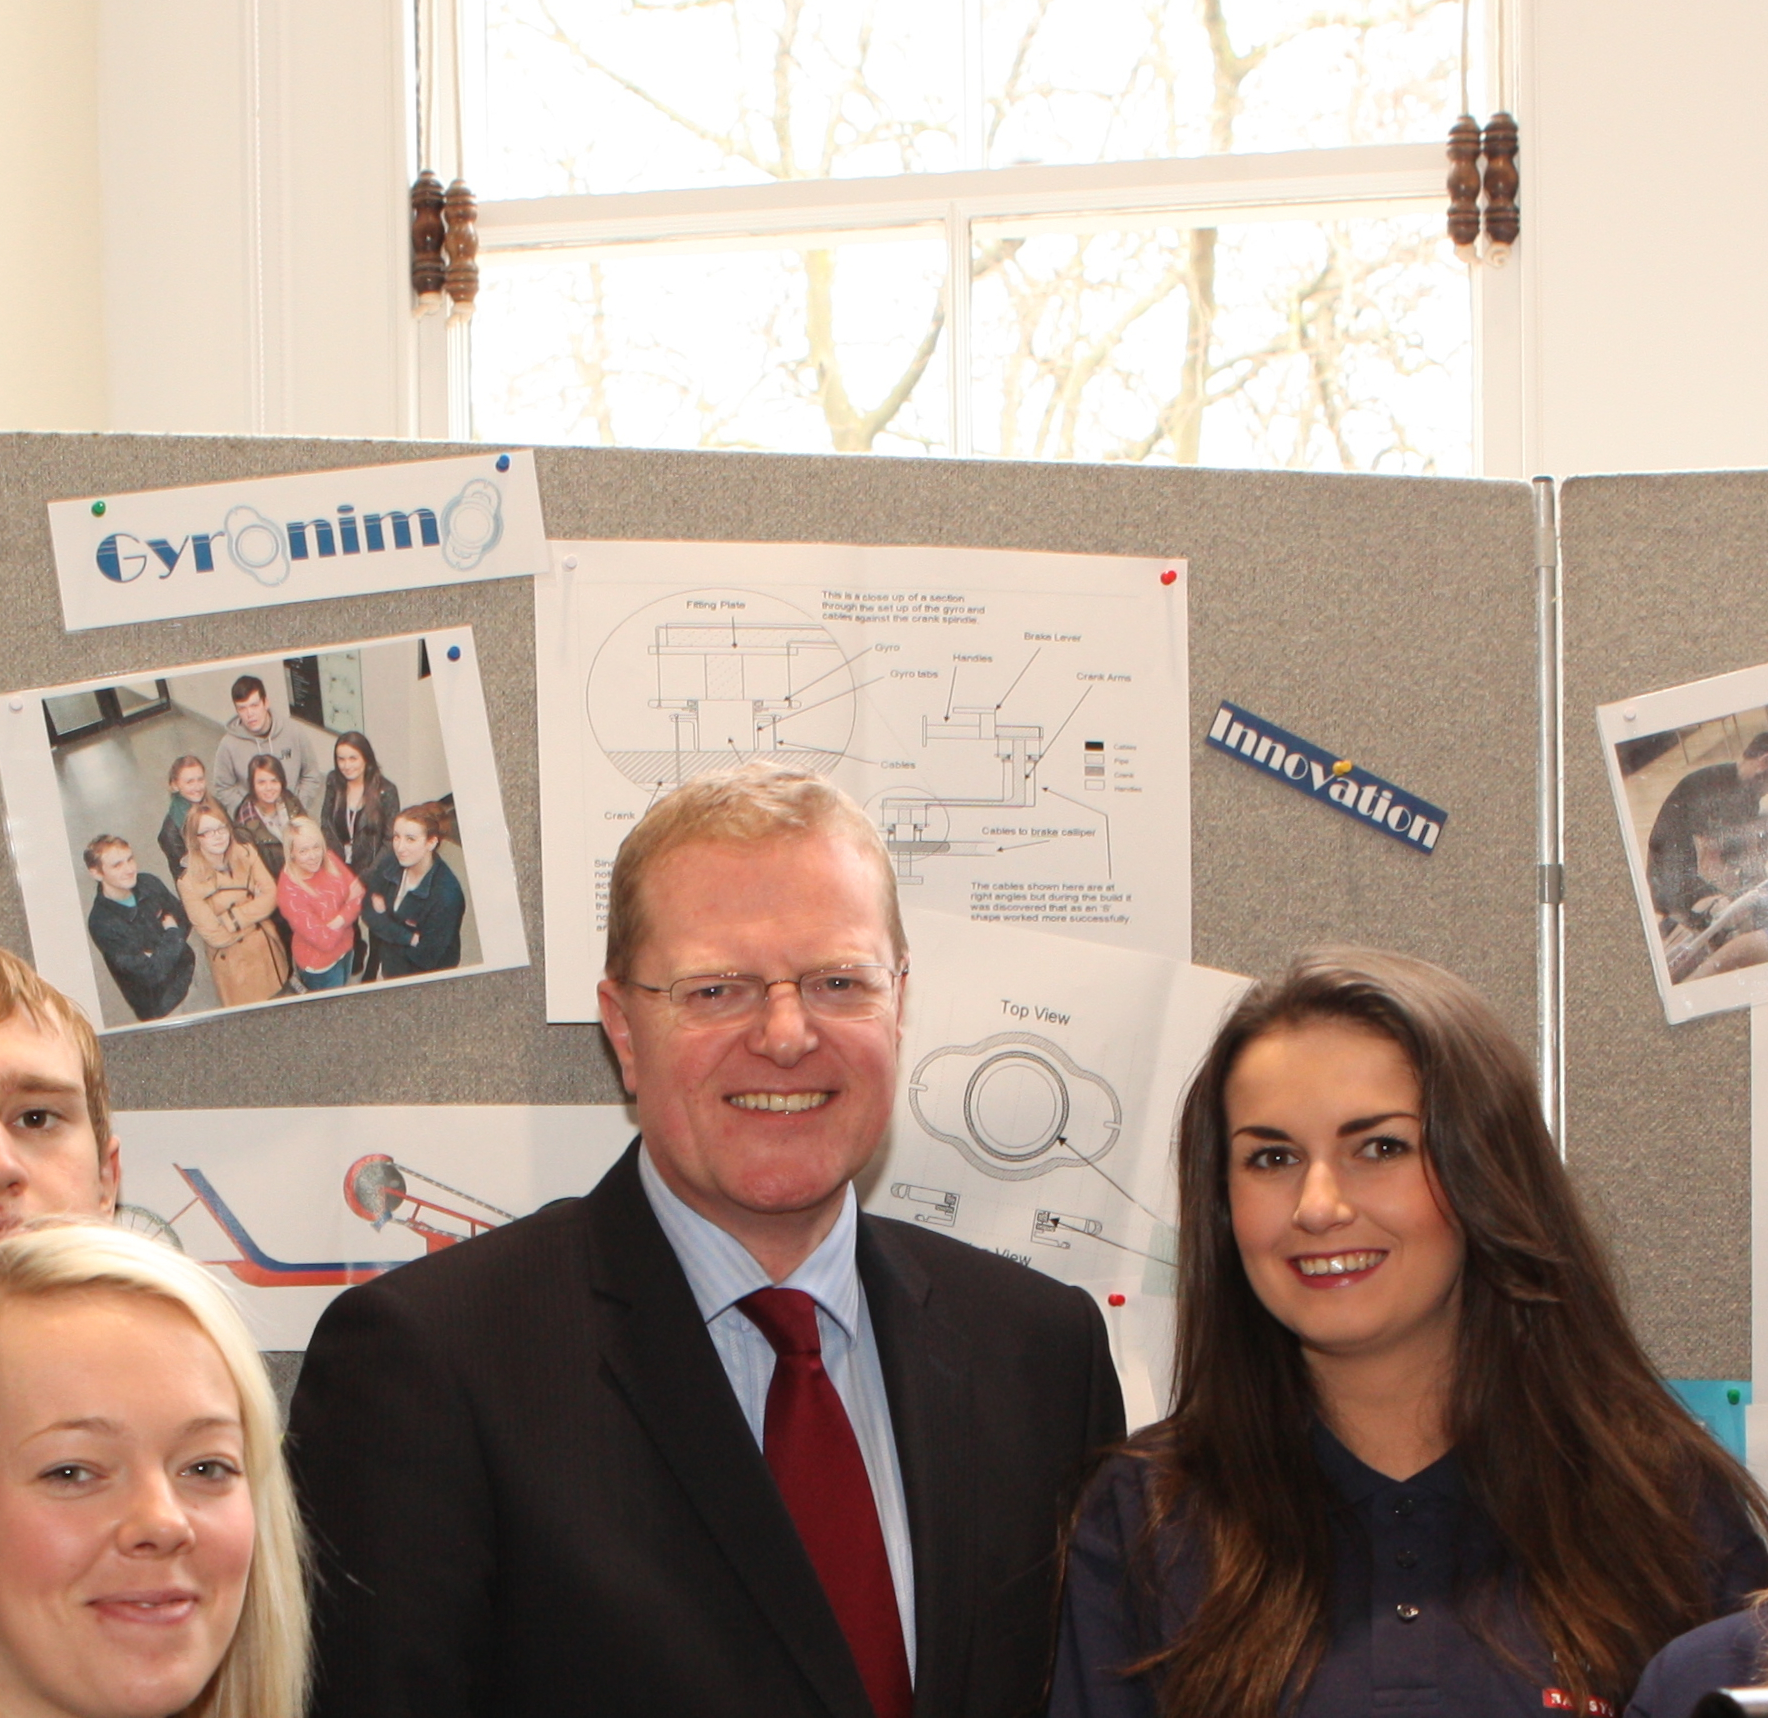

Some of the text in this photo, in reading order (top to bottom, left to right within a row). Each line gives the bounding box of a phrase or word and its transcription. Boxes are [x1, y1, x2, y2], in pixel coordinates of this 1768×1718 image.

[822, 590, 841, 600] This
[862, 593, 889, 602] close
[930, 594, 965, 603] section
[686, 600, 746, 611] Fitting Plate
[822, 602, 858, 613] through
[859, 603, 874, 612] the
[877, 604, 893, 612] set
[924, 604, 939, 613] the
[942, 606, 964, 616] gyro
[967, 605, 985, 614] and
[822, 612, 980, 625] cables against the crank spindle.
[1024, 632, 1082, 643] Brake Lever
[874, 643, 901, 654] Gyro
[952, 653, 993, 664] Handles
[890, 669, 939, 680] Gyro tabs
[1076, 672, 1132, 683] Crank Arms
[880, 760, 916, 770] Cables
[1208, 707, 1441, 850] Innovation
[604, 811, 635, 821] Crank
[981, 826, 1017, 836] Cables
[1031, 827, 1058, 837] brake
[1061, 828, 1097, 838] calliper
[971, 881, 990, 891] The
[992, 882, 1024, 891] cables
[1027, 882, 1059, 891] shown
[1062, 883, 1084, 891] here
[1086, 884, 1103, 892] are
[970, 892, 992, 902] right
[995, 893, 1027, 903] angles
[1030, 893, 1046, 901] but
[1048, 893, 1079, 903] during
[1081, 894, 1097, 902] the
[1100, 893, 1123, 902] build
[970, 904, 990, 912] was
[992, 903, 1047, 912] discovered
[1048, 903, 1067, 912] that
[970, 913, 1132, 925] shape worked more successfully.
[1000, 998, 1071, 1027] Top View
